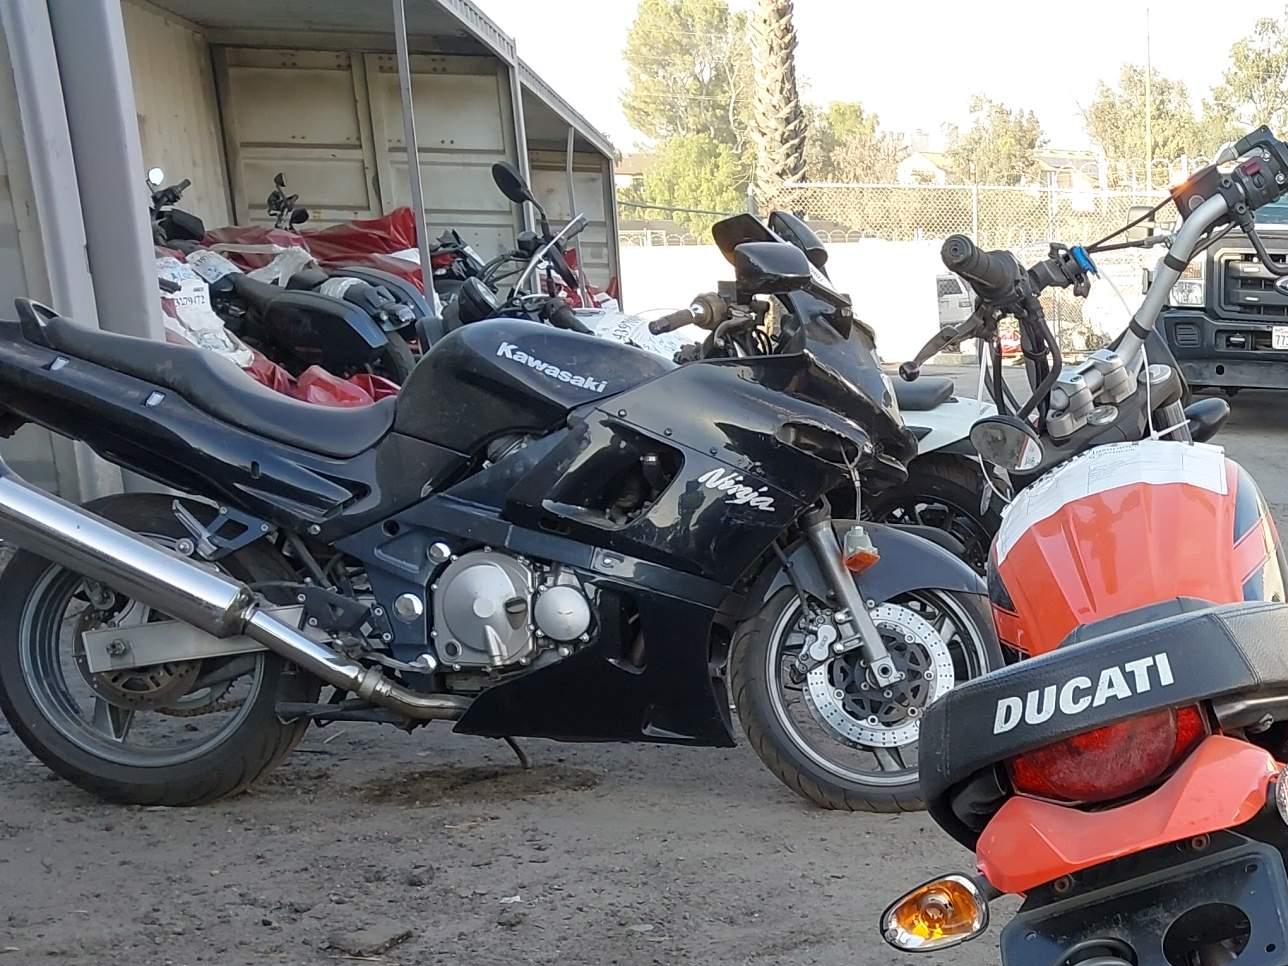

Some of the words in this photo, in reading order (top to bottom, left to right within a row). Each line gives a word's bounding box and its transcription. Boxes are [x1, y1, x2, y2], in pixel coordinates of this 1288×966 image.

[496, 341, 609, 393] Kawasaki
[697, 467, 776, 512] Ninja
[993, 651, 1175, 735] DUCATI
